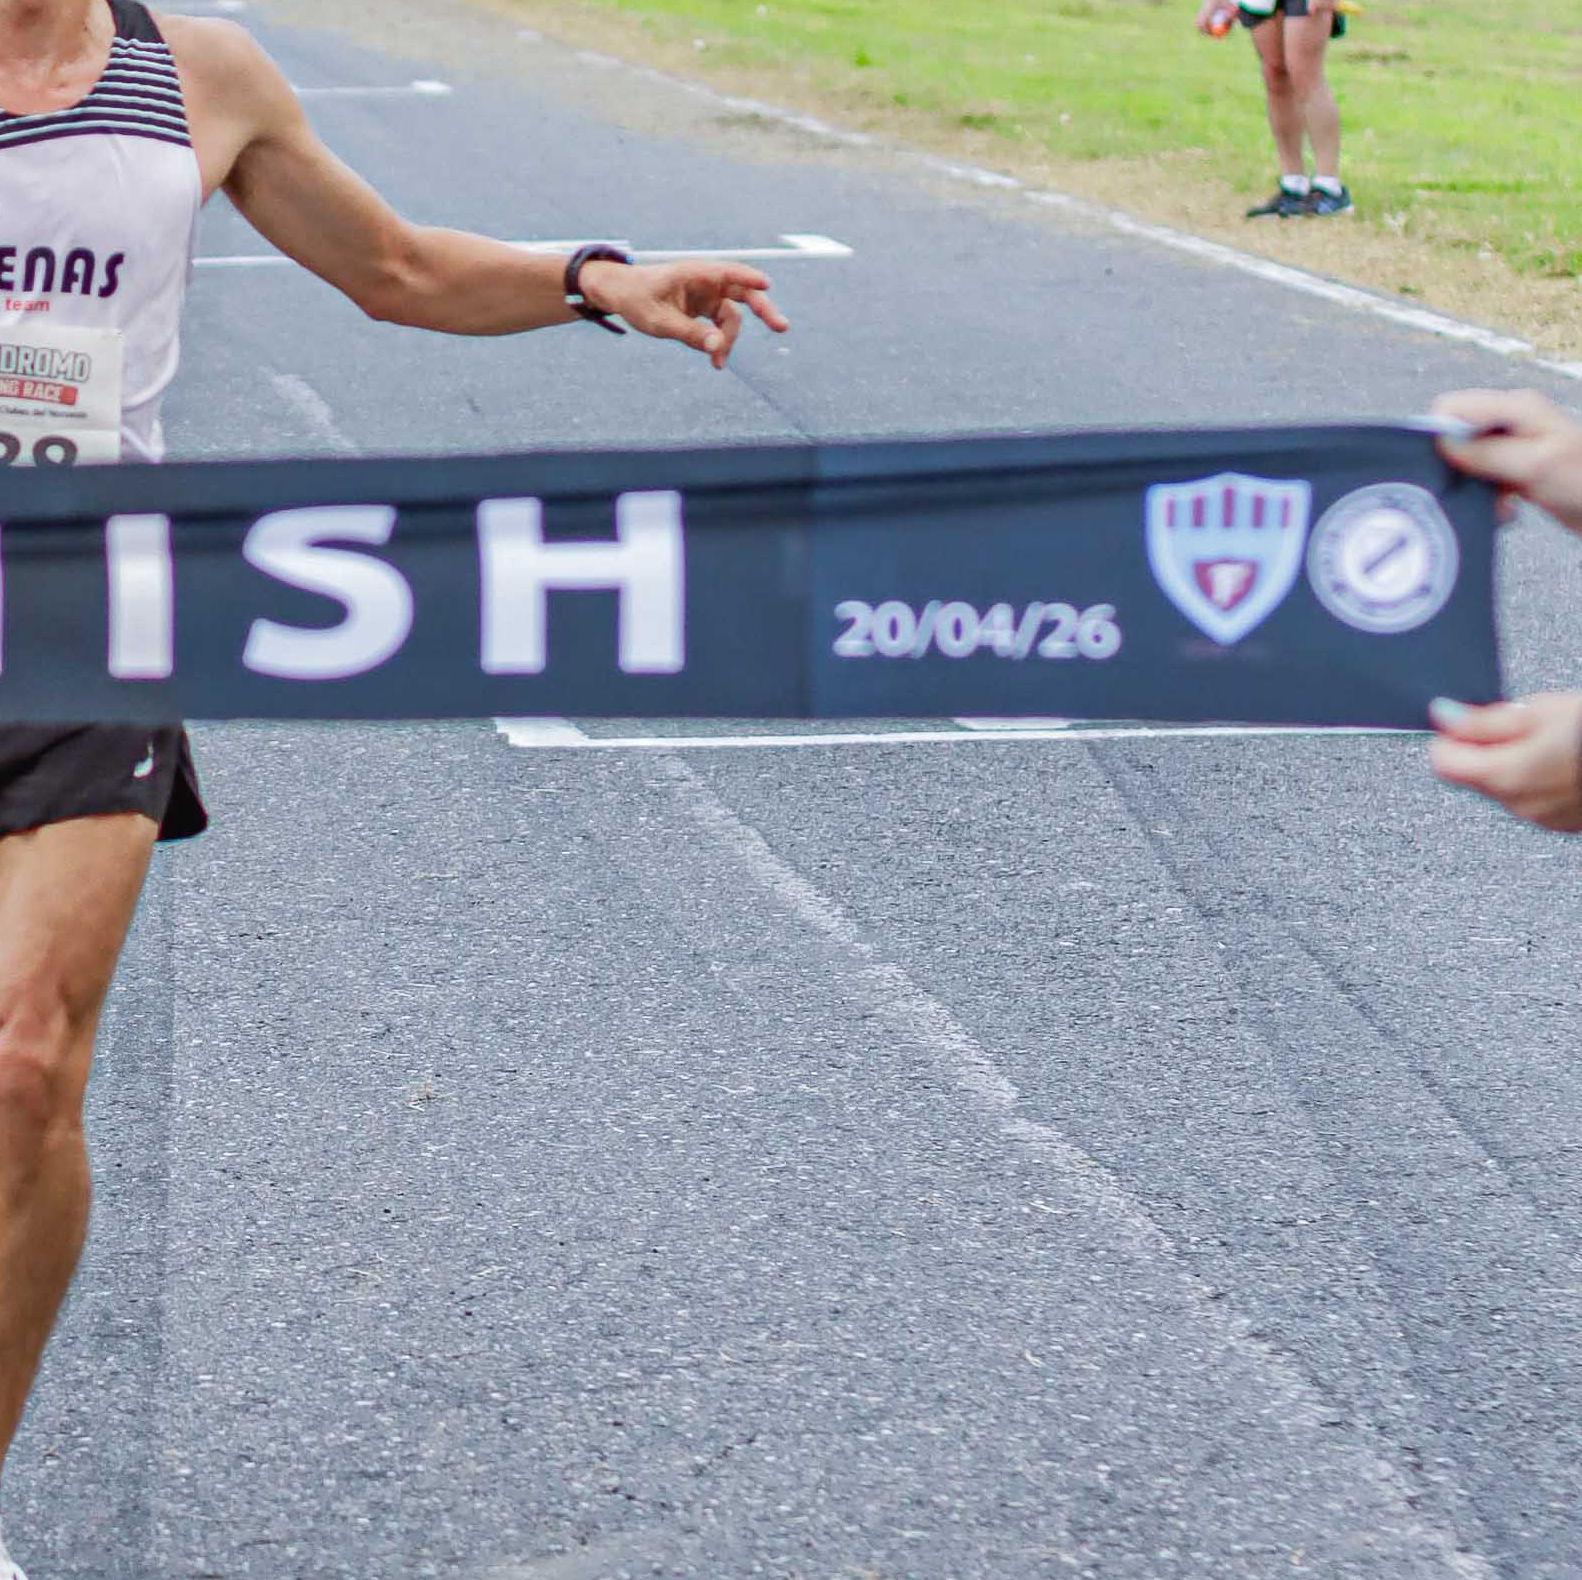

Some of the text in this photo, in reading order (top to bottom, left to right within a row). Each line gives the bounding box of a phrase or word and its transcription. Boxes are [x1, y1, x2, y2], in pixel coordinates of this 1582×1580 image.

[5, 296, 50, 311] team
[23, 380, 62, 402] RACE
[832, 599, 1122, 661] 20/04/26
